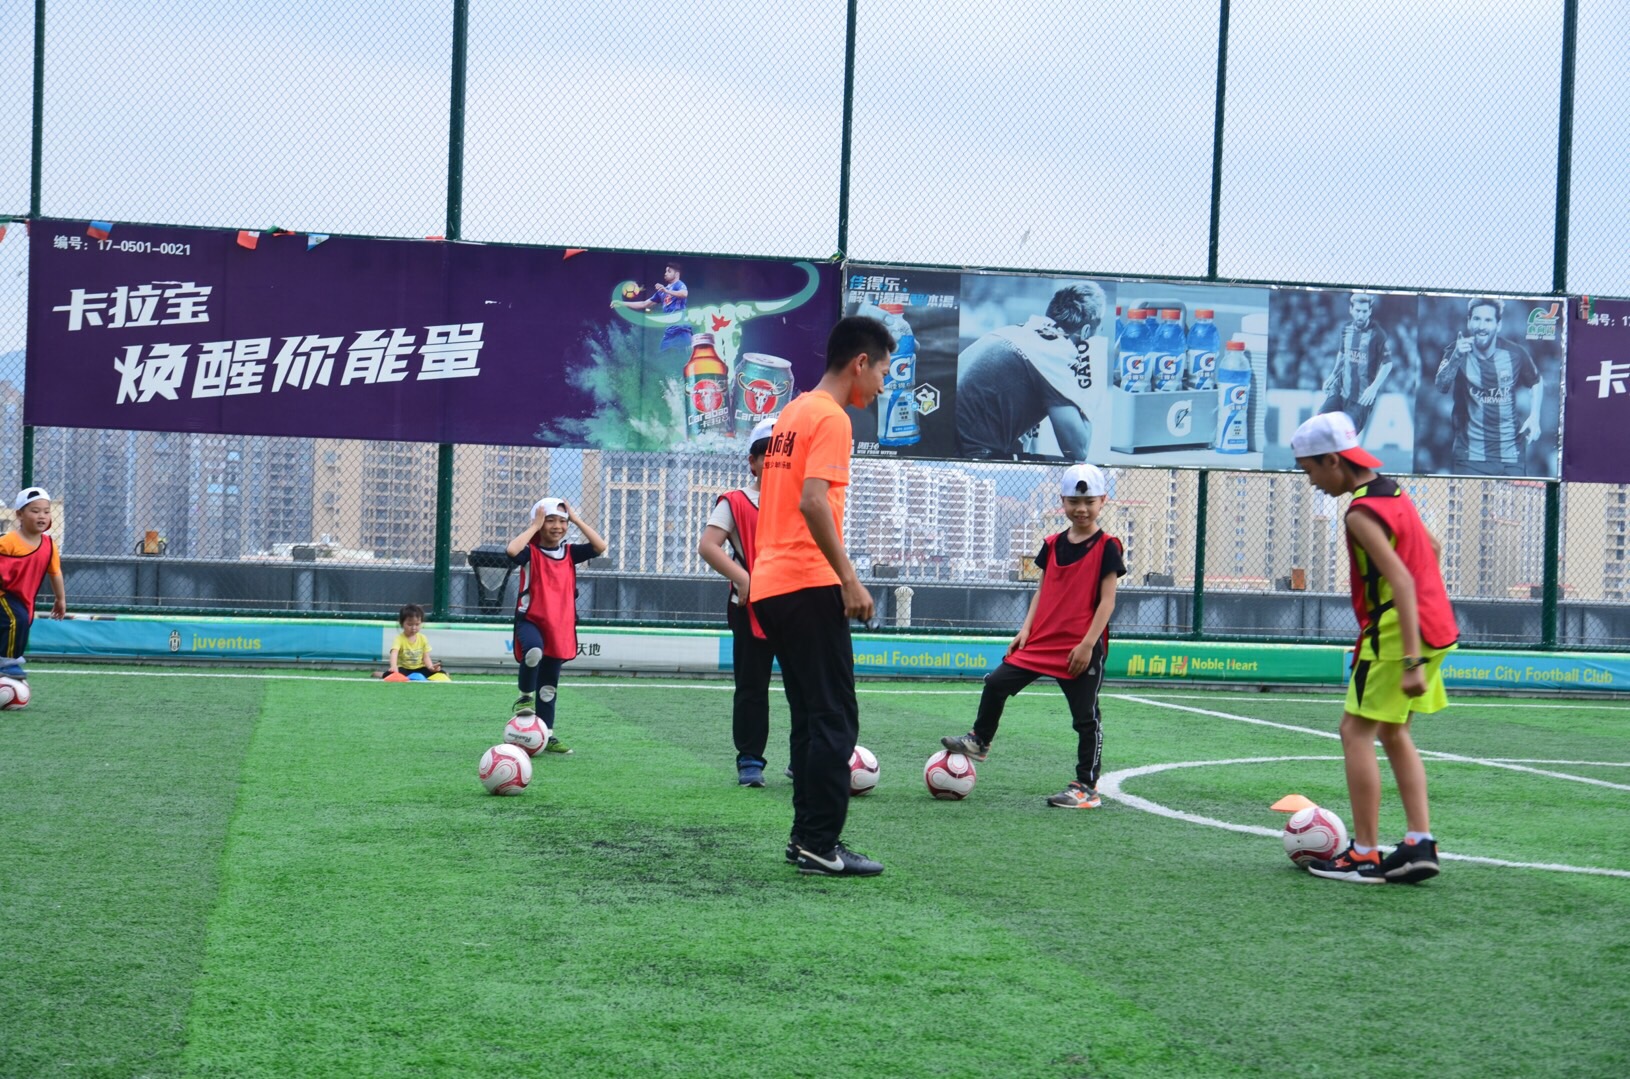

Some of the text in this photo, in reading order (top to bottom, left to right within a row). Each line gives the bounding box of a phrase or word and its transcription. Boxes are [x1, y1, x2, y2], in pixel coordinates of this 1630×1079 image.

[52, 280, 213, 331] 卡拉宝
[113, 322, 485, 405] 焕醒你能量
[191, 633, 262, 651] juventus
[852, 652, 987, 668] senal Football Club
[1191, 657, 1258, 671] Noble Heart
[1441, 665, 1613, 684] chester City Football Club
